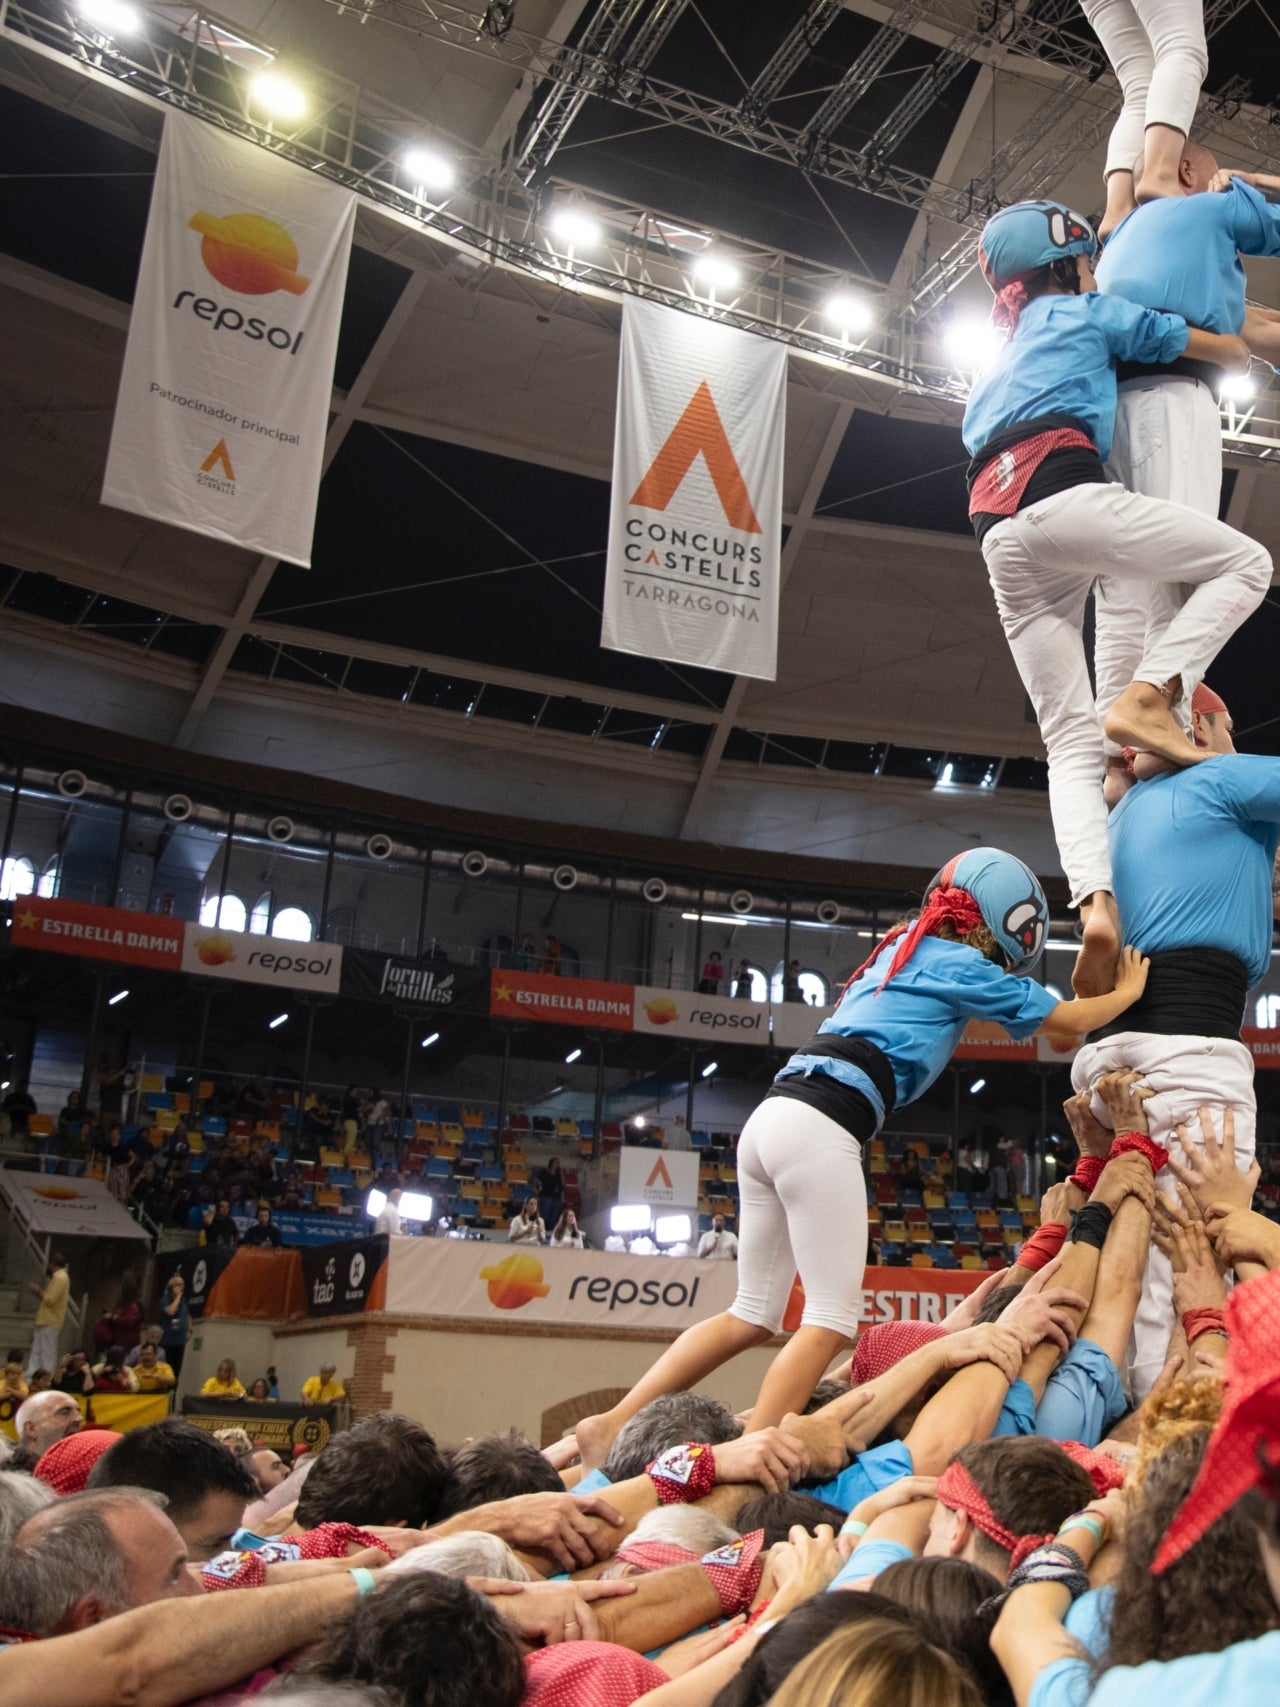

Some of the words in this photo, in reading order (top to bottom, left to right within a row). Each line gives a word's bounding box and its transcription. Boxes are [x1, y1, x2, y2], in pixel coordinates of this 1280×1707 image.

[173, 290, 304, 355] repsol
[149, 382, 239, 424] Patrocinador
[241, 418, 300, 446] principal
[626, 519, 762, 564] CONCURS
[624, 544, 761, 588] CASTELLS
[622, 580, 759, 623] TARRAGONA
[43, 918, 123, 944] ESTRELLA
[127, 932, 178, 953] DAMM
[247, 950, 333, 975] repsol
[516, 990, 583, 1011] ESTRELLA
[587, 1000, 630, 1016] DAMM
[689, 1008, 762, 1030] repsol
[313, 1278, 335, 1304] tac
[568, 1275, 700, 1310] repsol
